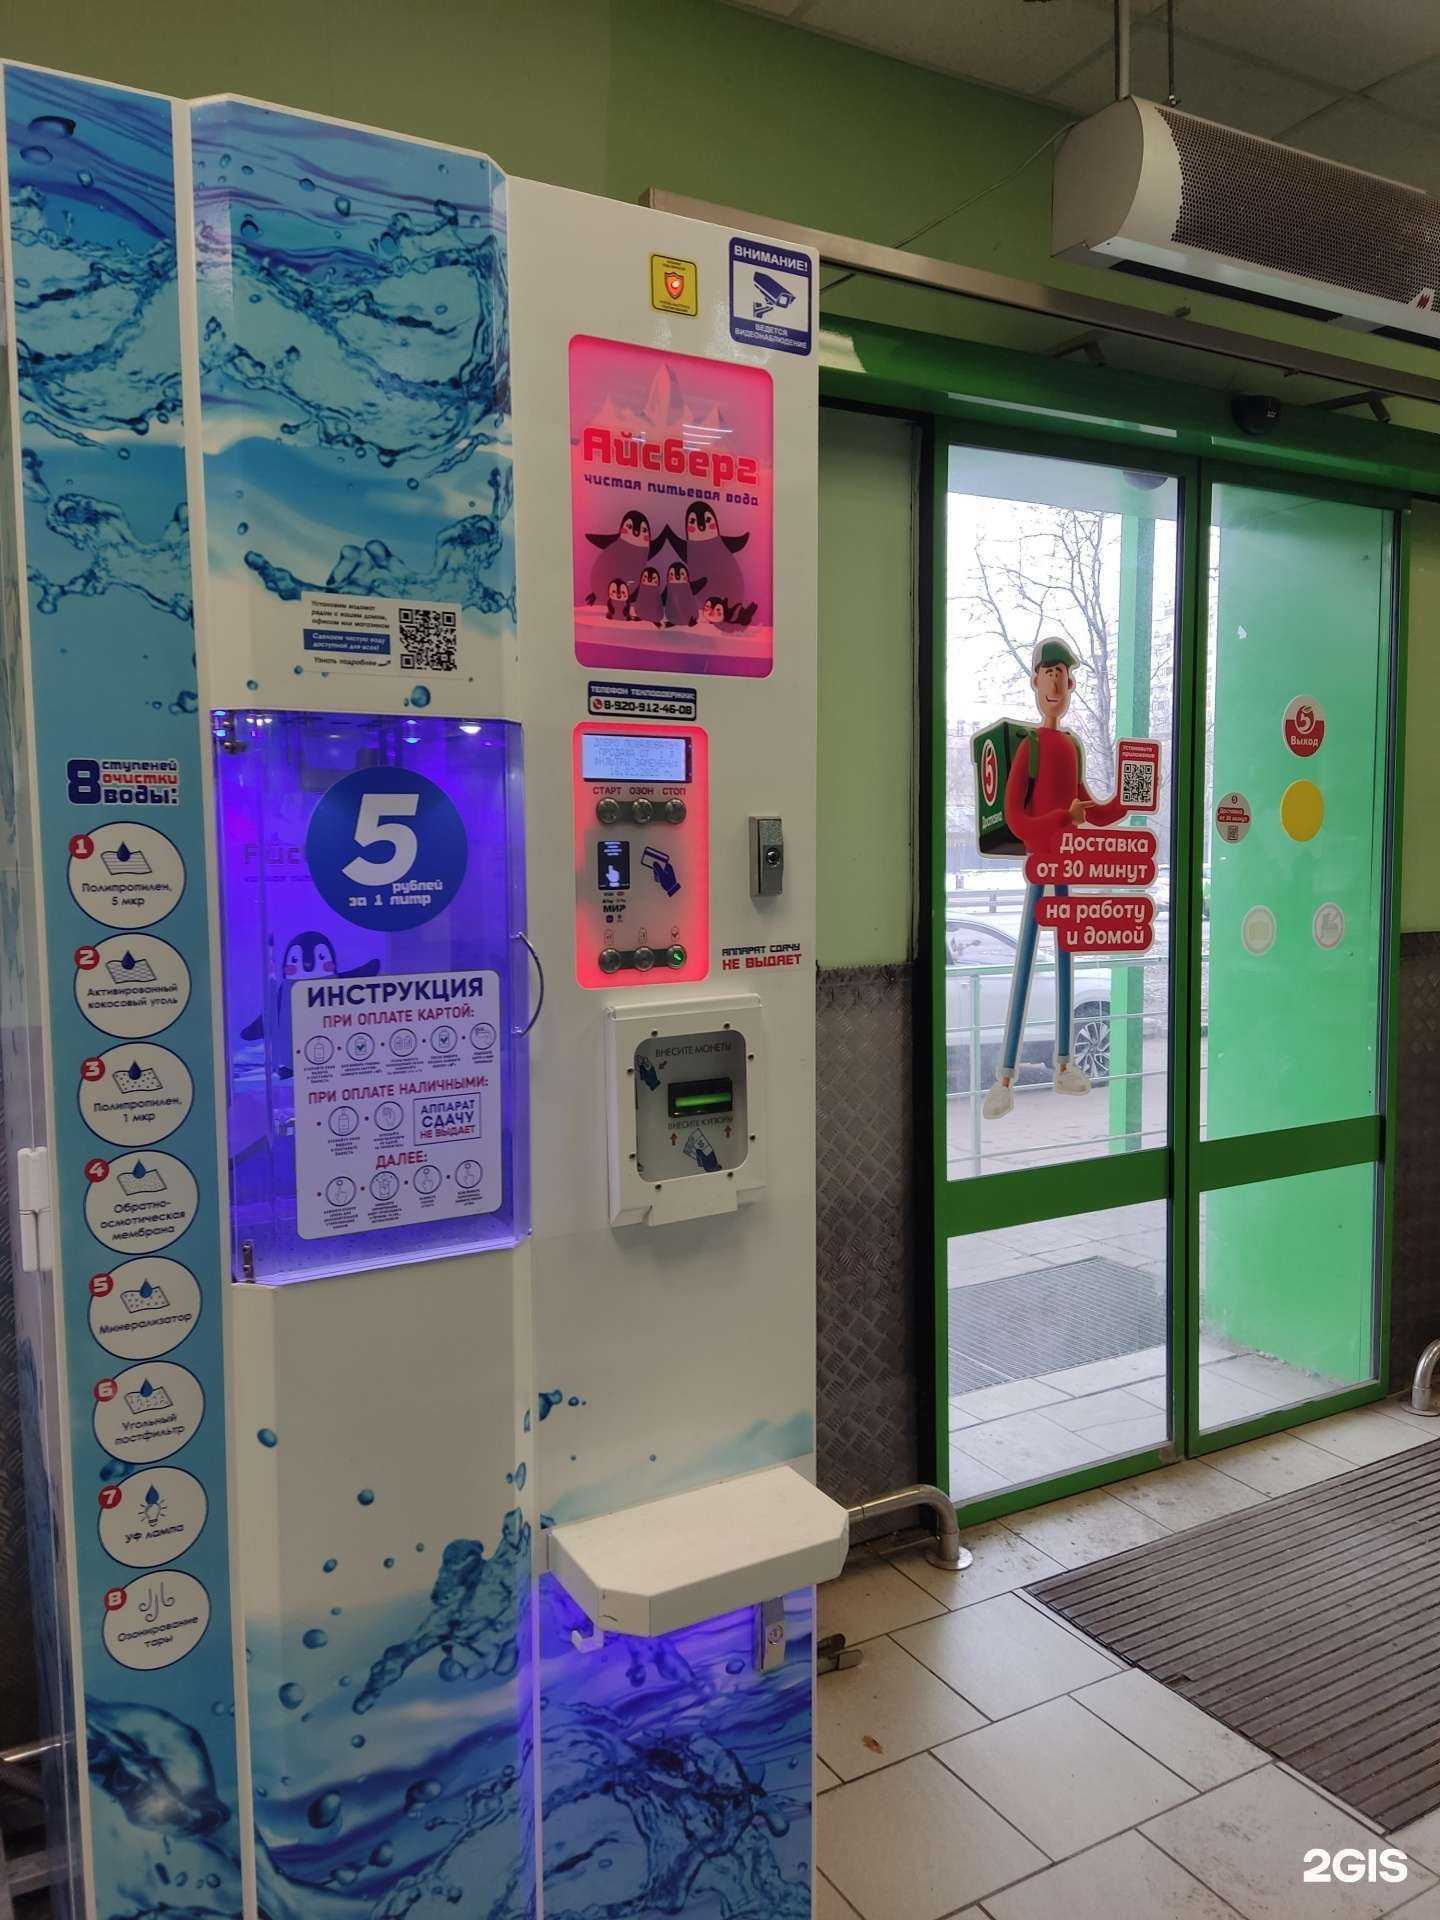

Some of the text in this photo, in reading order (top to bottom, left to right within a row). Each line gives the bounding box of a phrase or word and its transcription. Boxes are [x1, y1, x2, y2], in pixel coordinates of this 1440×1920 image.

[734, 244, 808, 272] ВНИМАНИЕ!
[755, 323, 788, 337] ВЕДЕТСЯ
[583, 427, 760, 487] Айсберг
[584, 474, 759, 506] чистая питьевая вода
[1290, 736, 1318, 747] Выход
[102, 760, 177, 772] ступеней
[67, 759, 100, 804] 8
[102, 773, 178, 784] очистки
[104, 785, 177, 804] воды:
[593, 786, 686, 795] СТАРТ ОЗОН СТОП
[76, 838, 87, 854] 1
[342, 793, 420, 886] 5
[1060, 833, 1148, 854] Доставка
[1036, 860, 1148, 882] от 30 минут
[392, 879, 443, 893] рублей
[112, 897, 145, 907] 5 мкр
[348, 893, 431, 907] за 1 литр
[1046, 901, 1146, 923] на работу
[1067, 926, 1144, 945] и домой
[79, 950, 95, 965] 2
[722, 943, 801, 956] АППАРАТ СДАЧУ
[722, 954, 802, 971] НЕ ВЫДАЕТ
[87, 984, 178, 997] Активированный
[307, 977, 483, 1008] ИНСТРУКЦИЯ
[88, 997, 178, 1009] кокосовый уголь
[322, 1003, 475, 1029] ПРИ ОПЛАТЕ КАРТОЙ:
[655, 1045, 693, 1058] ВНЕСИТЕ
[85, 1061, 100, 1077] 3
[308, 1076, 489, 1105] ПРИ ОПЛАТЕ НАЛИЧНЫМИ:
[421, 1100, 476, 1114] АППАРАТ
[123, 1113, 155, 1123] 1 мкр
[422, 1111, 475, 1129] СДАЧУ
[420, 1124, 476, 1139] НЕ ВЫДАЕТ
[375, 1151, 428, 1170] ДАЛЕЕ:
[89, 1162, 105, 1178] 4
[114, 1201, 173, 1214] Обратно-
[100, 1211, 186, 1229] осмотическая
[111, 1225, 175, 1241] мембрана
[93, 1277, 108, 1293] 5
[99, 1313, 193, 1335] Минерализатор
[99, 1382, 113, 1397] 6
[121, 1412, 177, 1432] Угольный
[115, 1425, 186, 1446] постфильтр
[102, 1490, 116, 1505] 7
[145, 1524, 184, 1540] лампа
[108, 1591, 123, 1607] 8
[117, 1615, 199, 1643] Озонирование
[143, 1634, 174, 1649] тары
